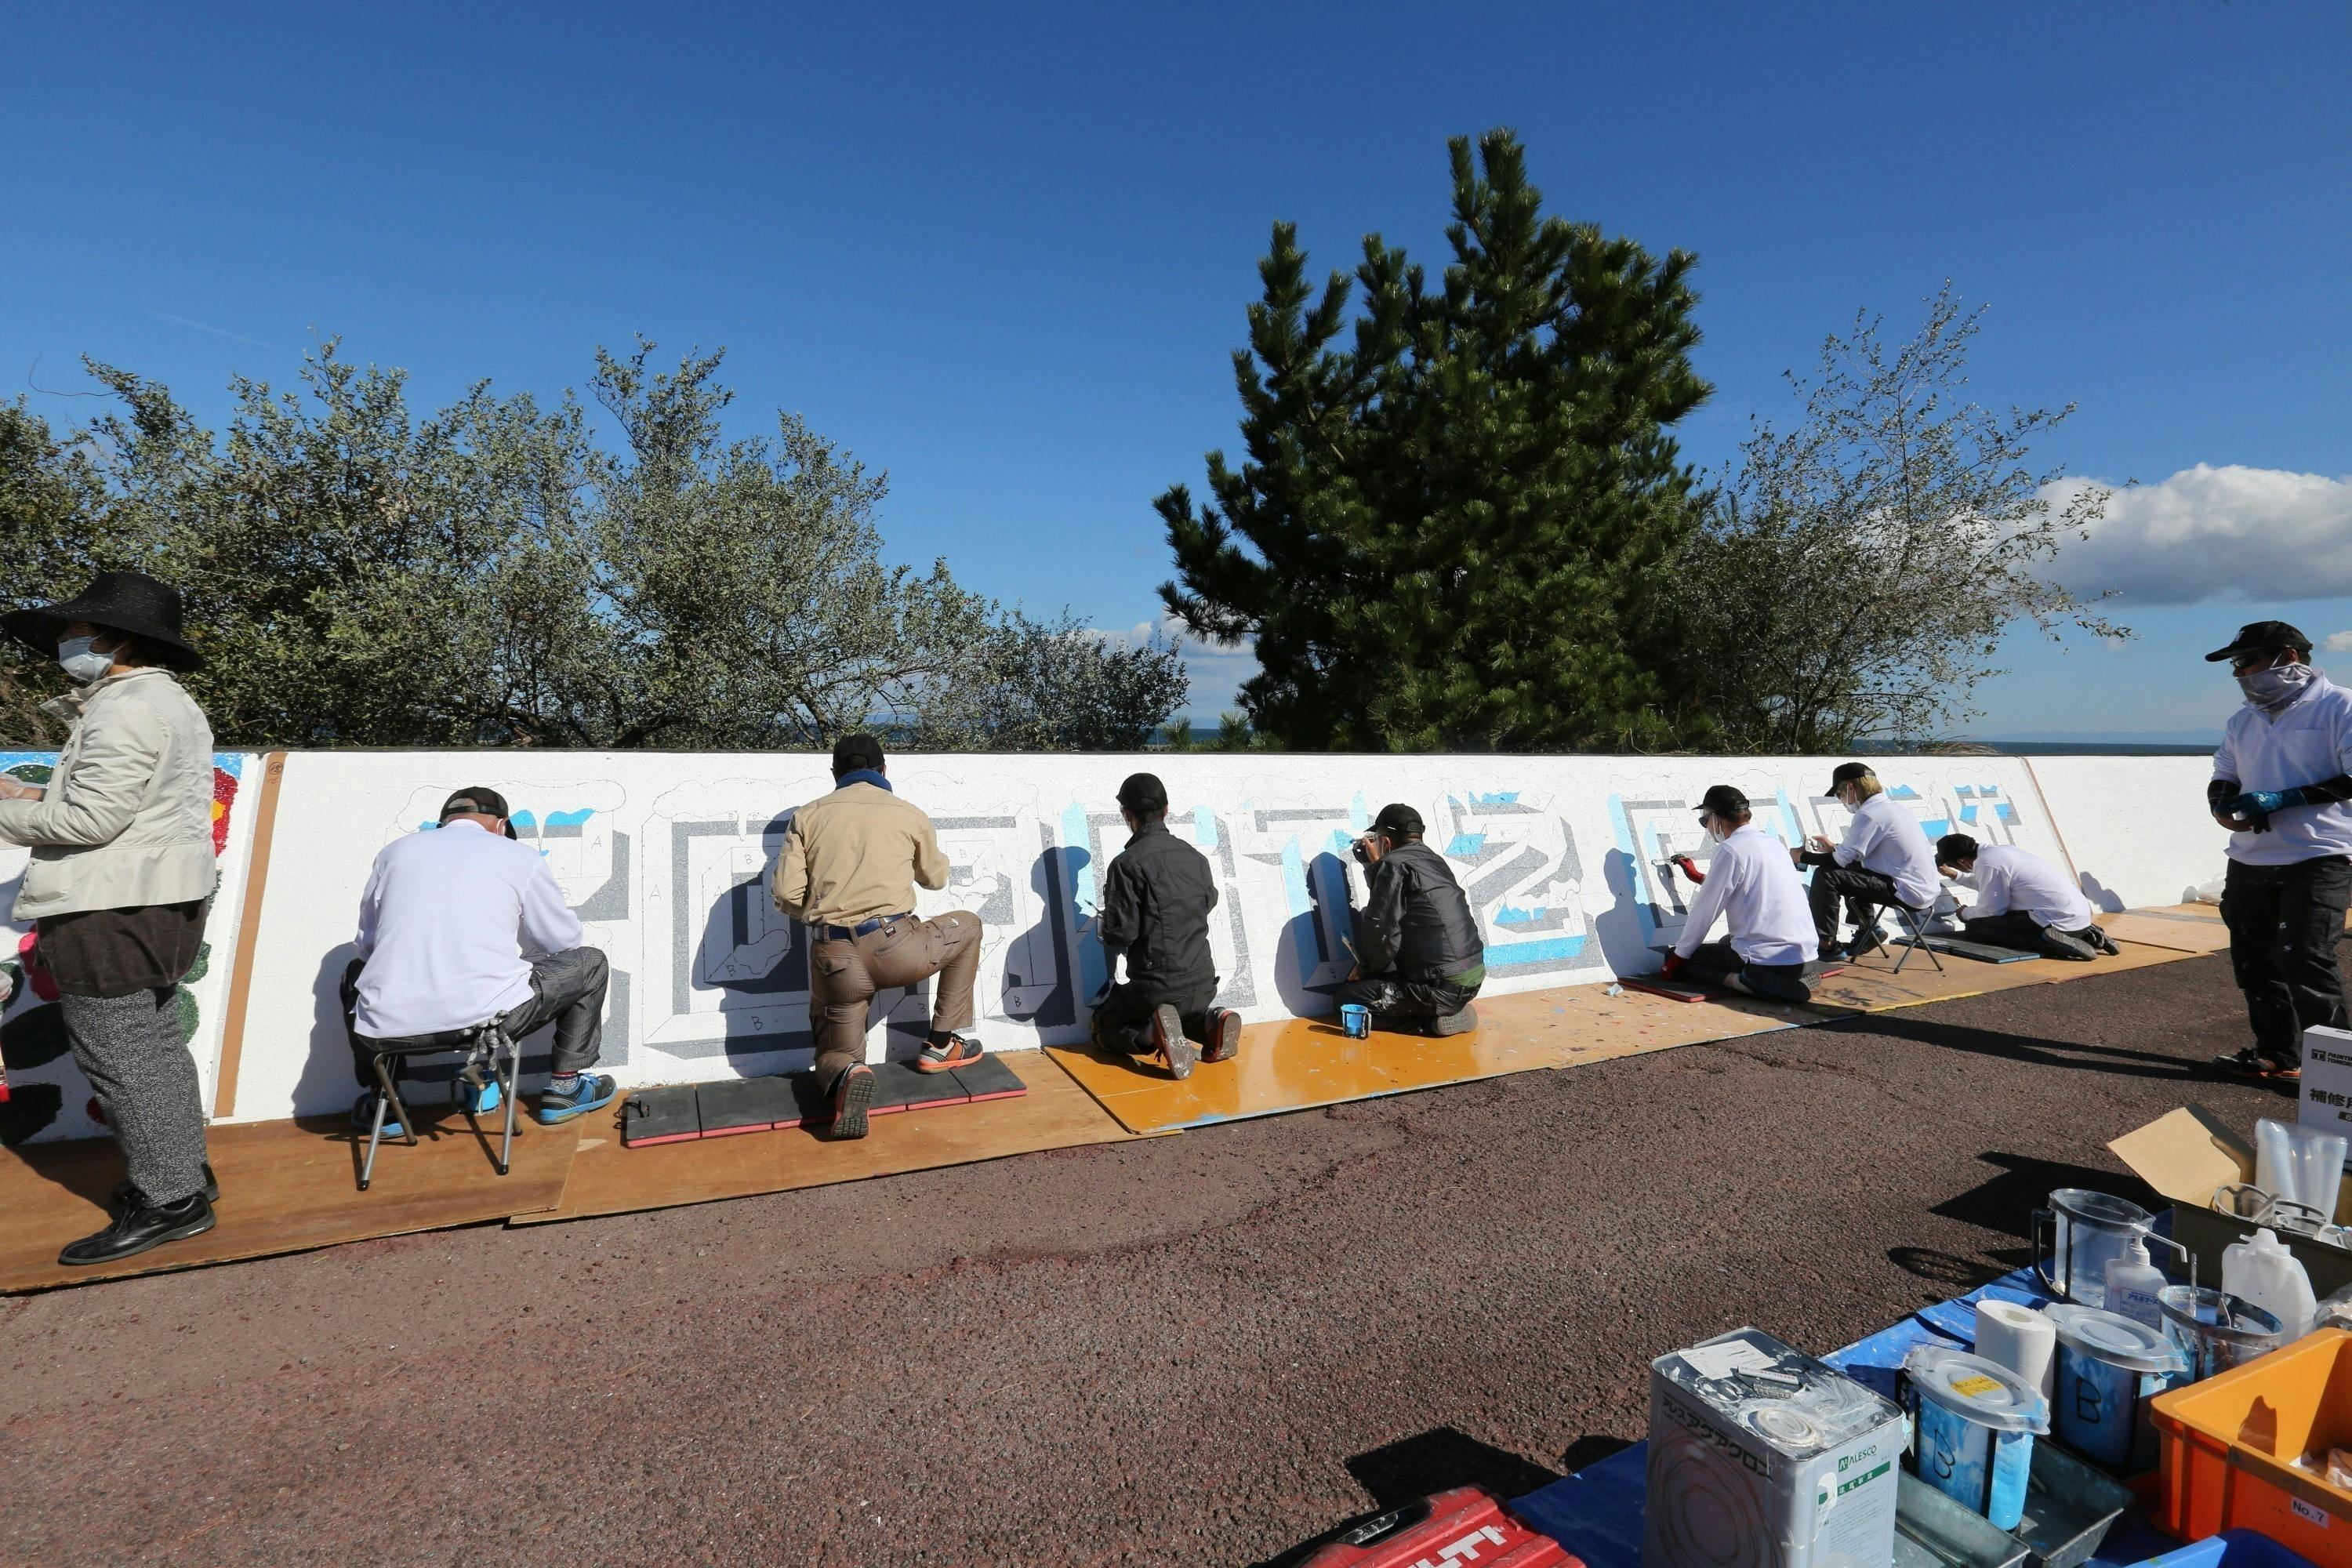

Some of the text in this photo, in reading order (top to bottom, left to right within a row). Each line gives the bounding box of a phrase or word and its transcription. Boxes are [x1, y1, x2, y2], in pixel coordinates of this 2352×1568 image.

[648, 884, 662, 902] A
[752, 1015, 764, 1031] B
[2076, 1376, 2102, 1424] B
[1849, 1445, 1877, 1466] ALESCO
[1933, 1428, 1956, 1479] B
